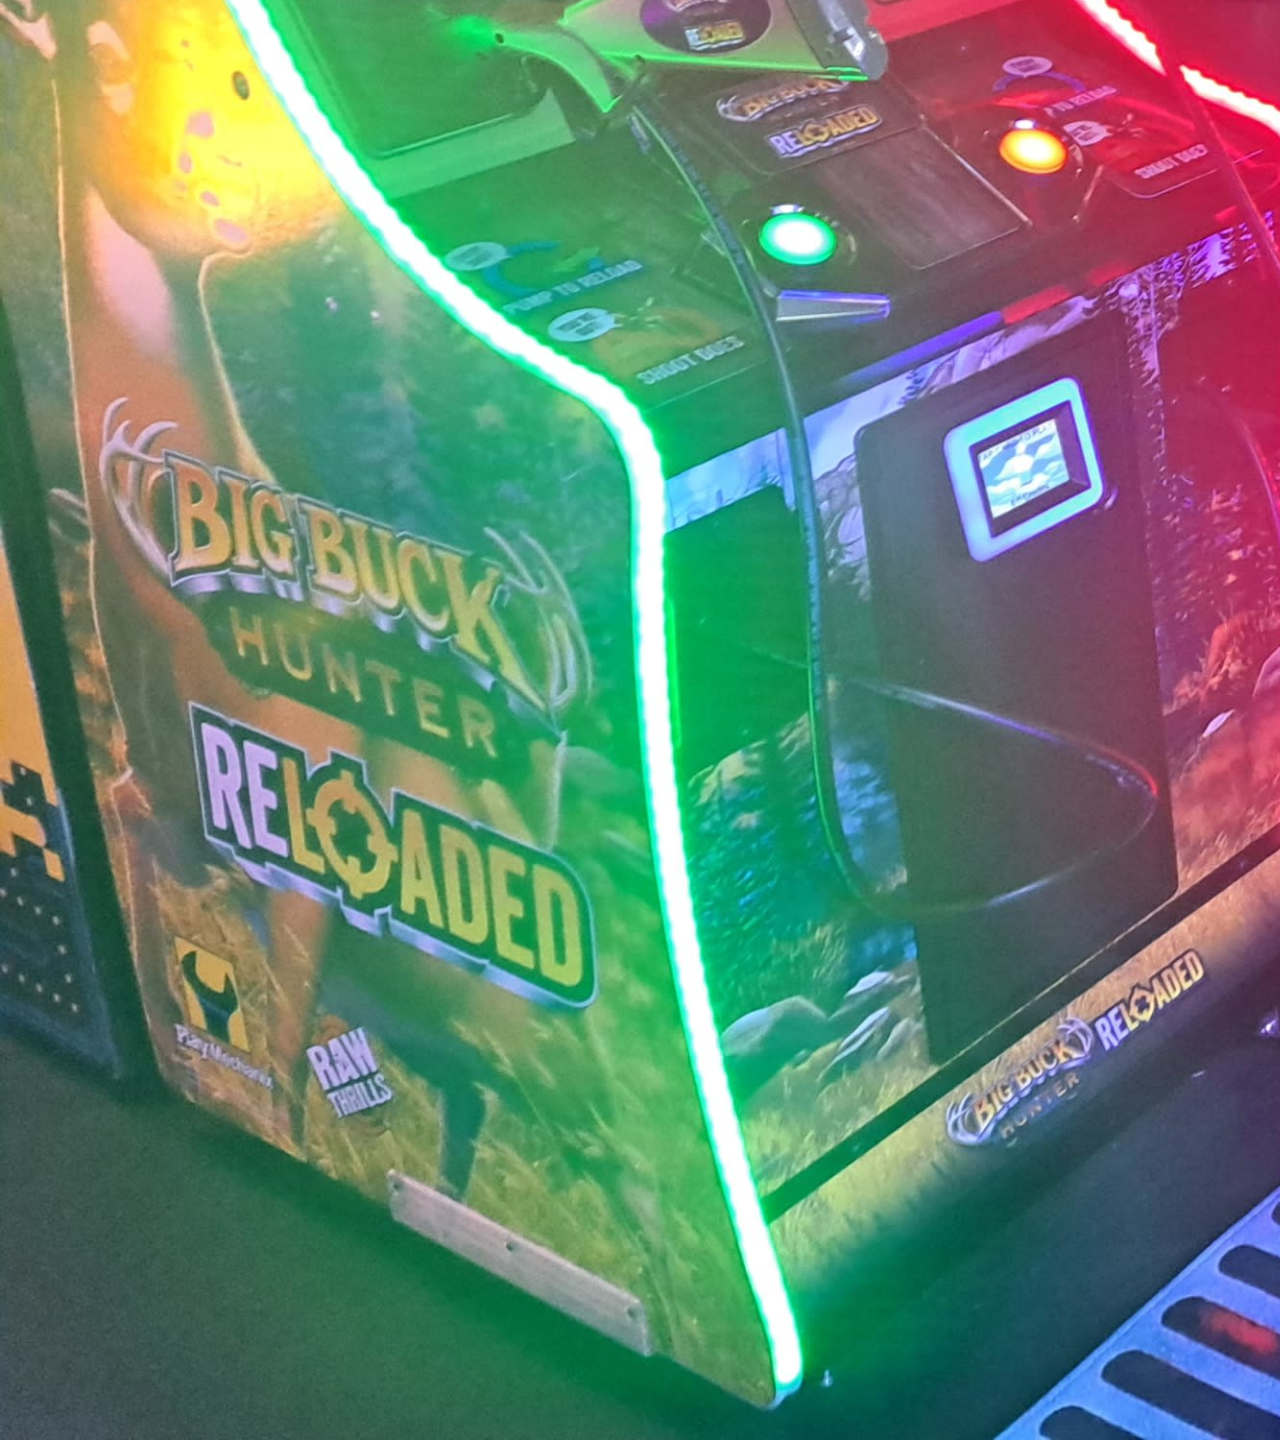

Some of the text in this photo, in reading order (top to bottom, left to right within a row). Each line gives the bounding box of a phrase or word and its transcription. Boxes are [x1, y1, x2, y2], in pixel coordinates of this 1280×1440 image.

[168, 462, 548, 711] BIG BUCK
[229, 605, 499, 760] HUNTER
[200, 720, 584, 988] RELOADED
[1094, 950, 1206, 1051] RELOADED
[306, 1026, 378, 1092] RAW
[327, 1072, 393, 1120] THRILLS
[973, 1040, 1075, 1131] BIG BUCK
